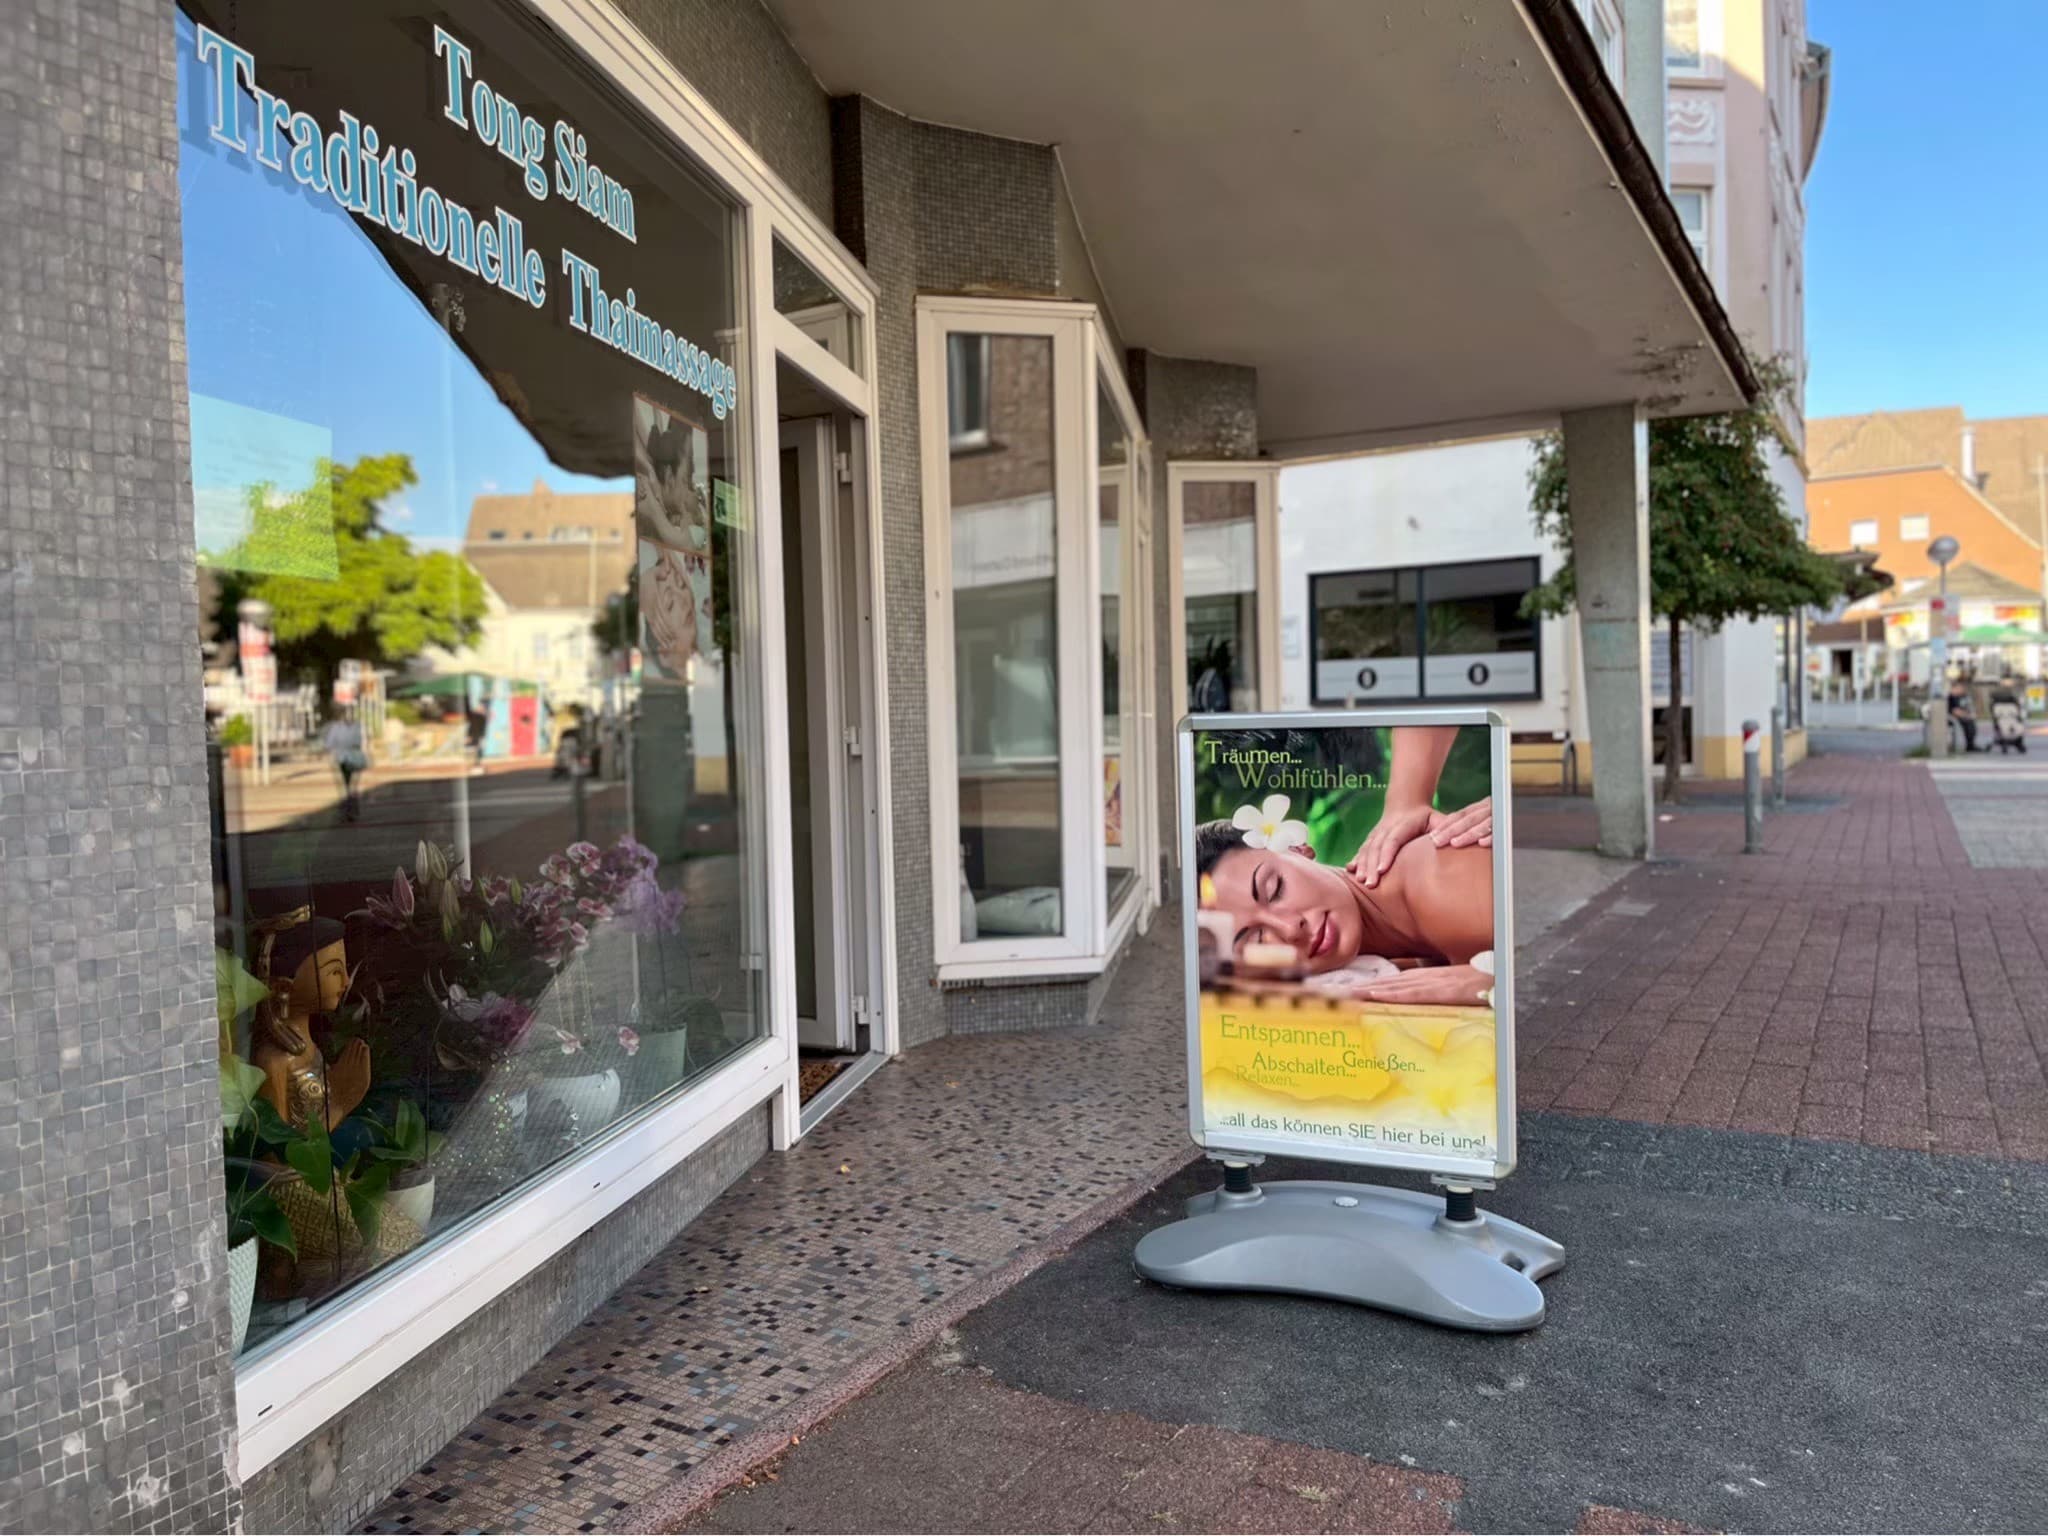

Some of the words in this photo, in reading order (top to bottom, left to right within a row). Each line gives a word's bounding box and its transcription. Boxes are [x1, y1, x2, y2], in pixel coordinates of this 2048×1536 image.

[197, 24, 546, 309] Traditionelle
[562, 249, 736, 420] Thaimassage
[433, 25, 548, 200] Tong
[553, 120, 637, 243] Siam
[1251, 1115, 1278, 1130] das
[1283, 1117, 1342, 1136] können
[1348, 1123, 1377, 1139] SIE
[1382, 1126, 1413, 1143] hier
[1420, 1129, 1445, 1147] bei
